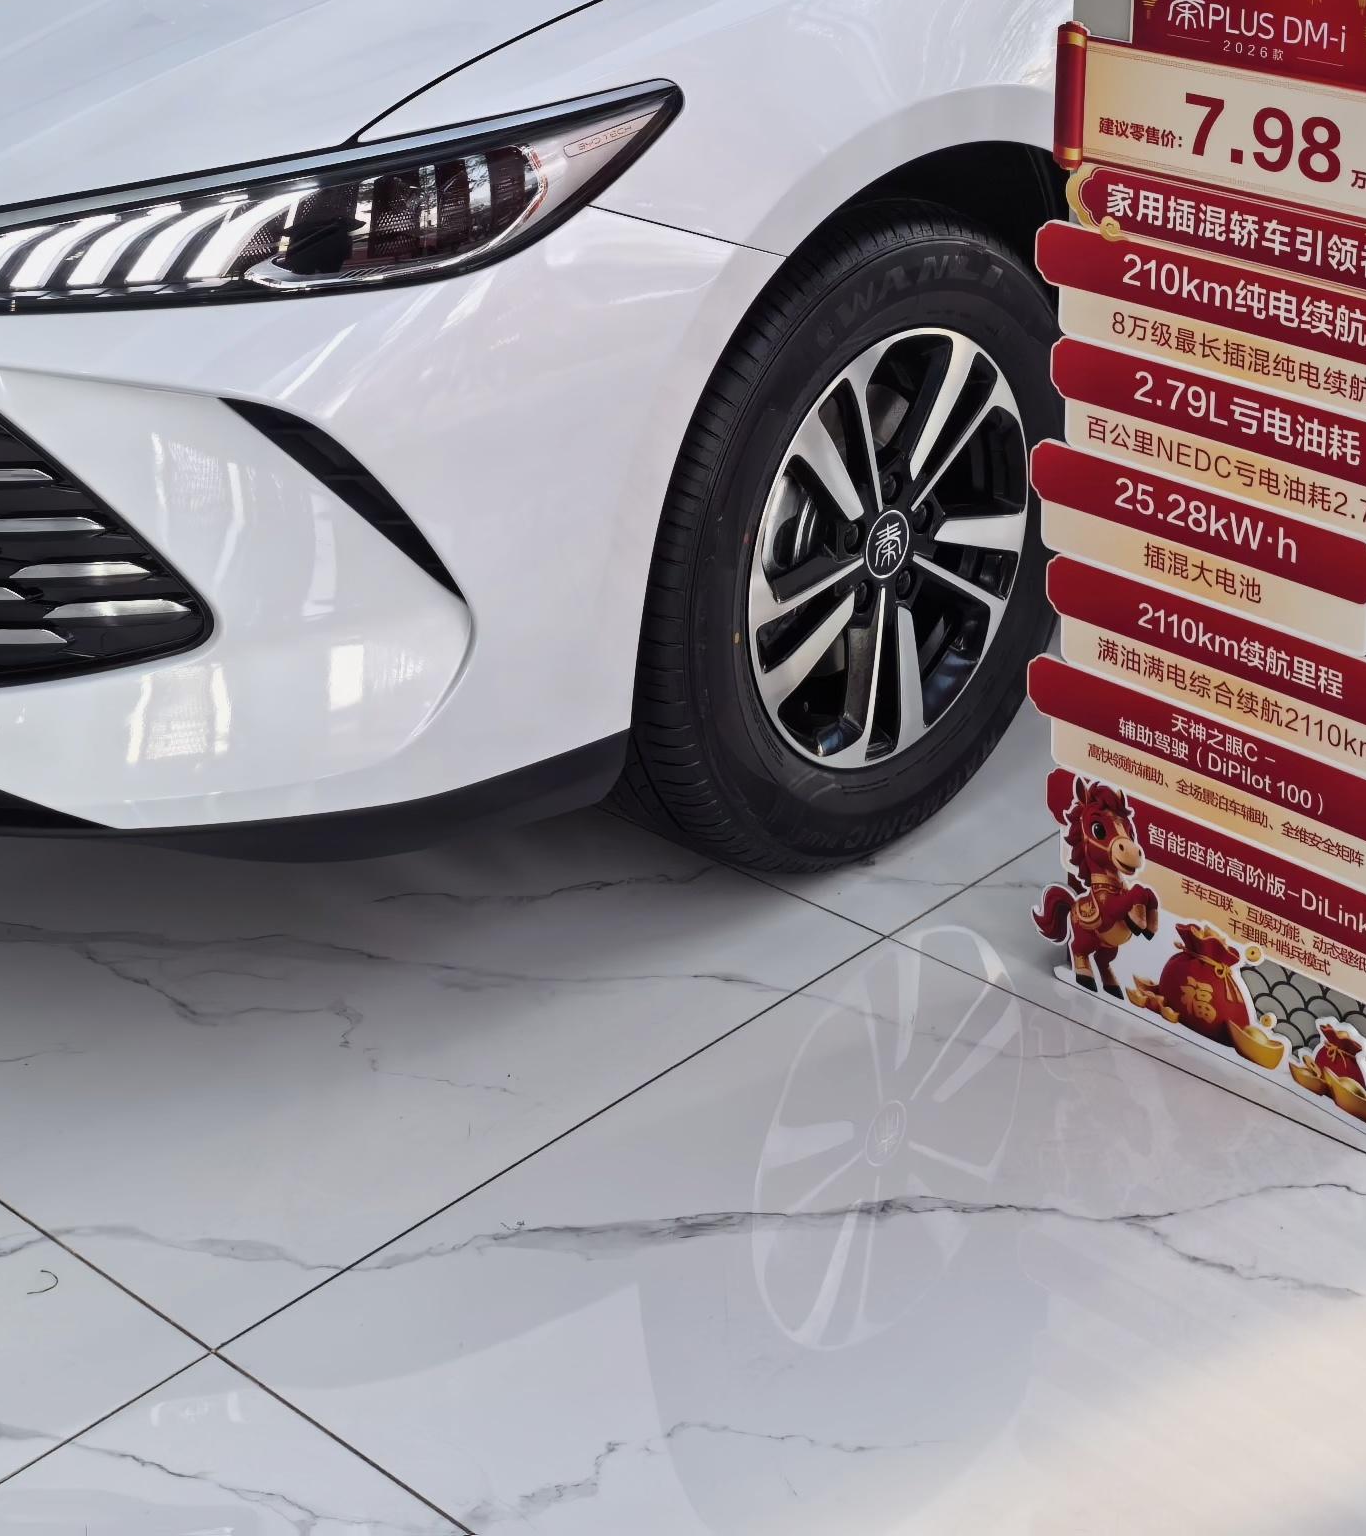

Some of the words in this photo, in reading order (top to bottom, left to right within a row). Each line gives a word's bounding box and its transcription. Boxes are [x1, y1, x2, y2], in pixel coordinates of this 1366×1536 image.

[1223, 39, 1285, 63] 2026款
[1282, 13, 1348, 55] DM-i
[1098, 115, 1184, 150] 建议零售价:
[1184, 92, 1342, 184] 7.98
[1114, 477, 1298, 564] 25.28kW·h
[1143, 541, 1263, 605] 插混大电池
[1136, 601, 1345, 700] 2110km续航里程
[1170, 713, 1258, 762] 天神之眼C
[1227, 917, 1332, 977] 千里眼+哨兵模式
